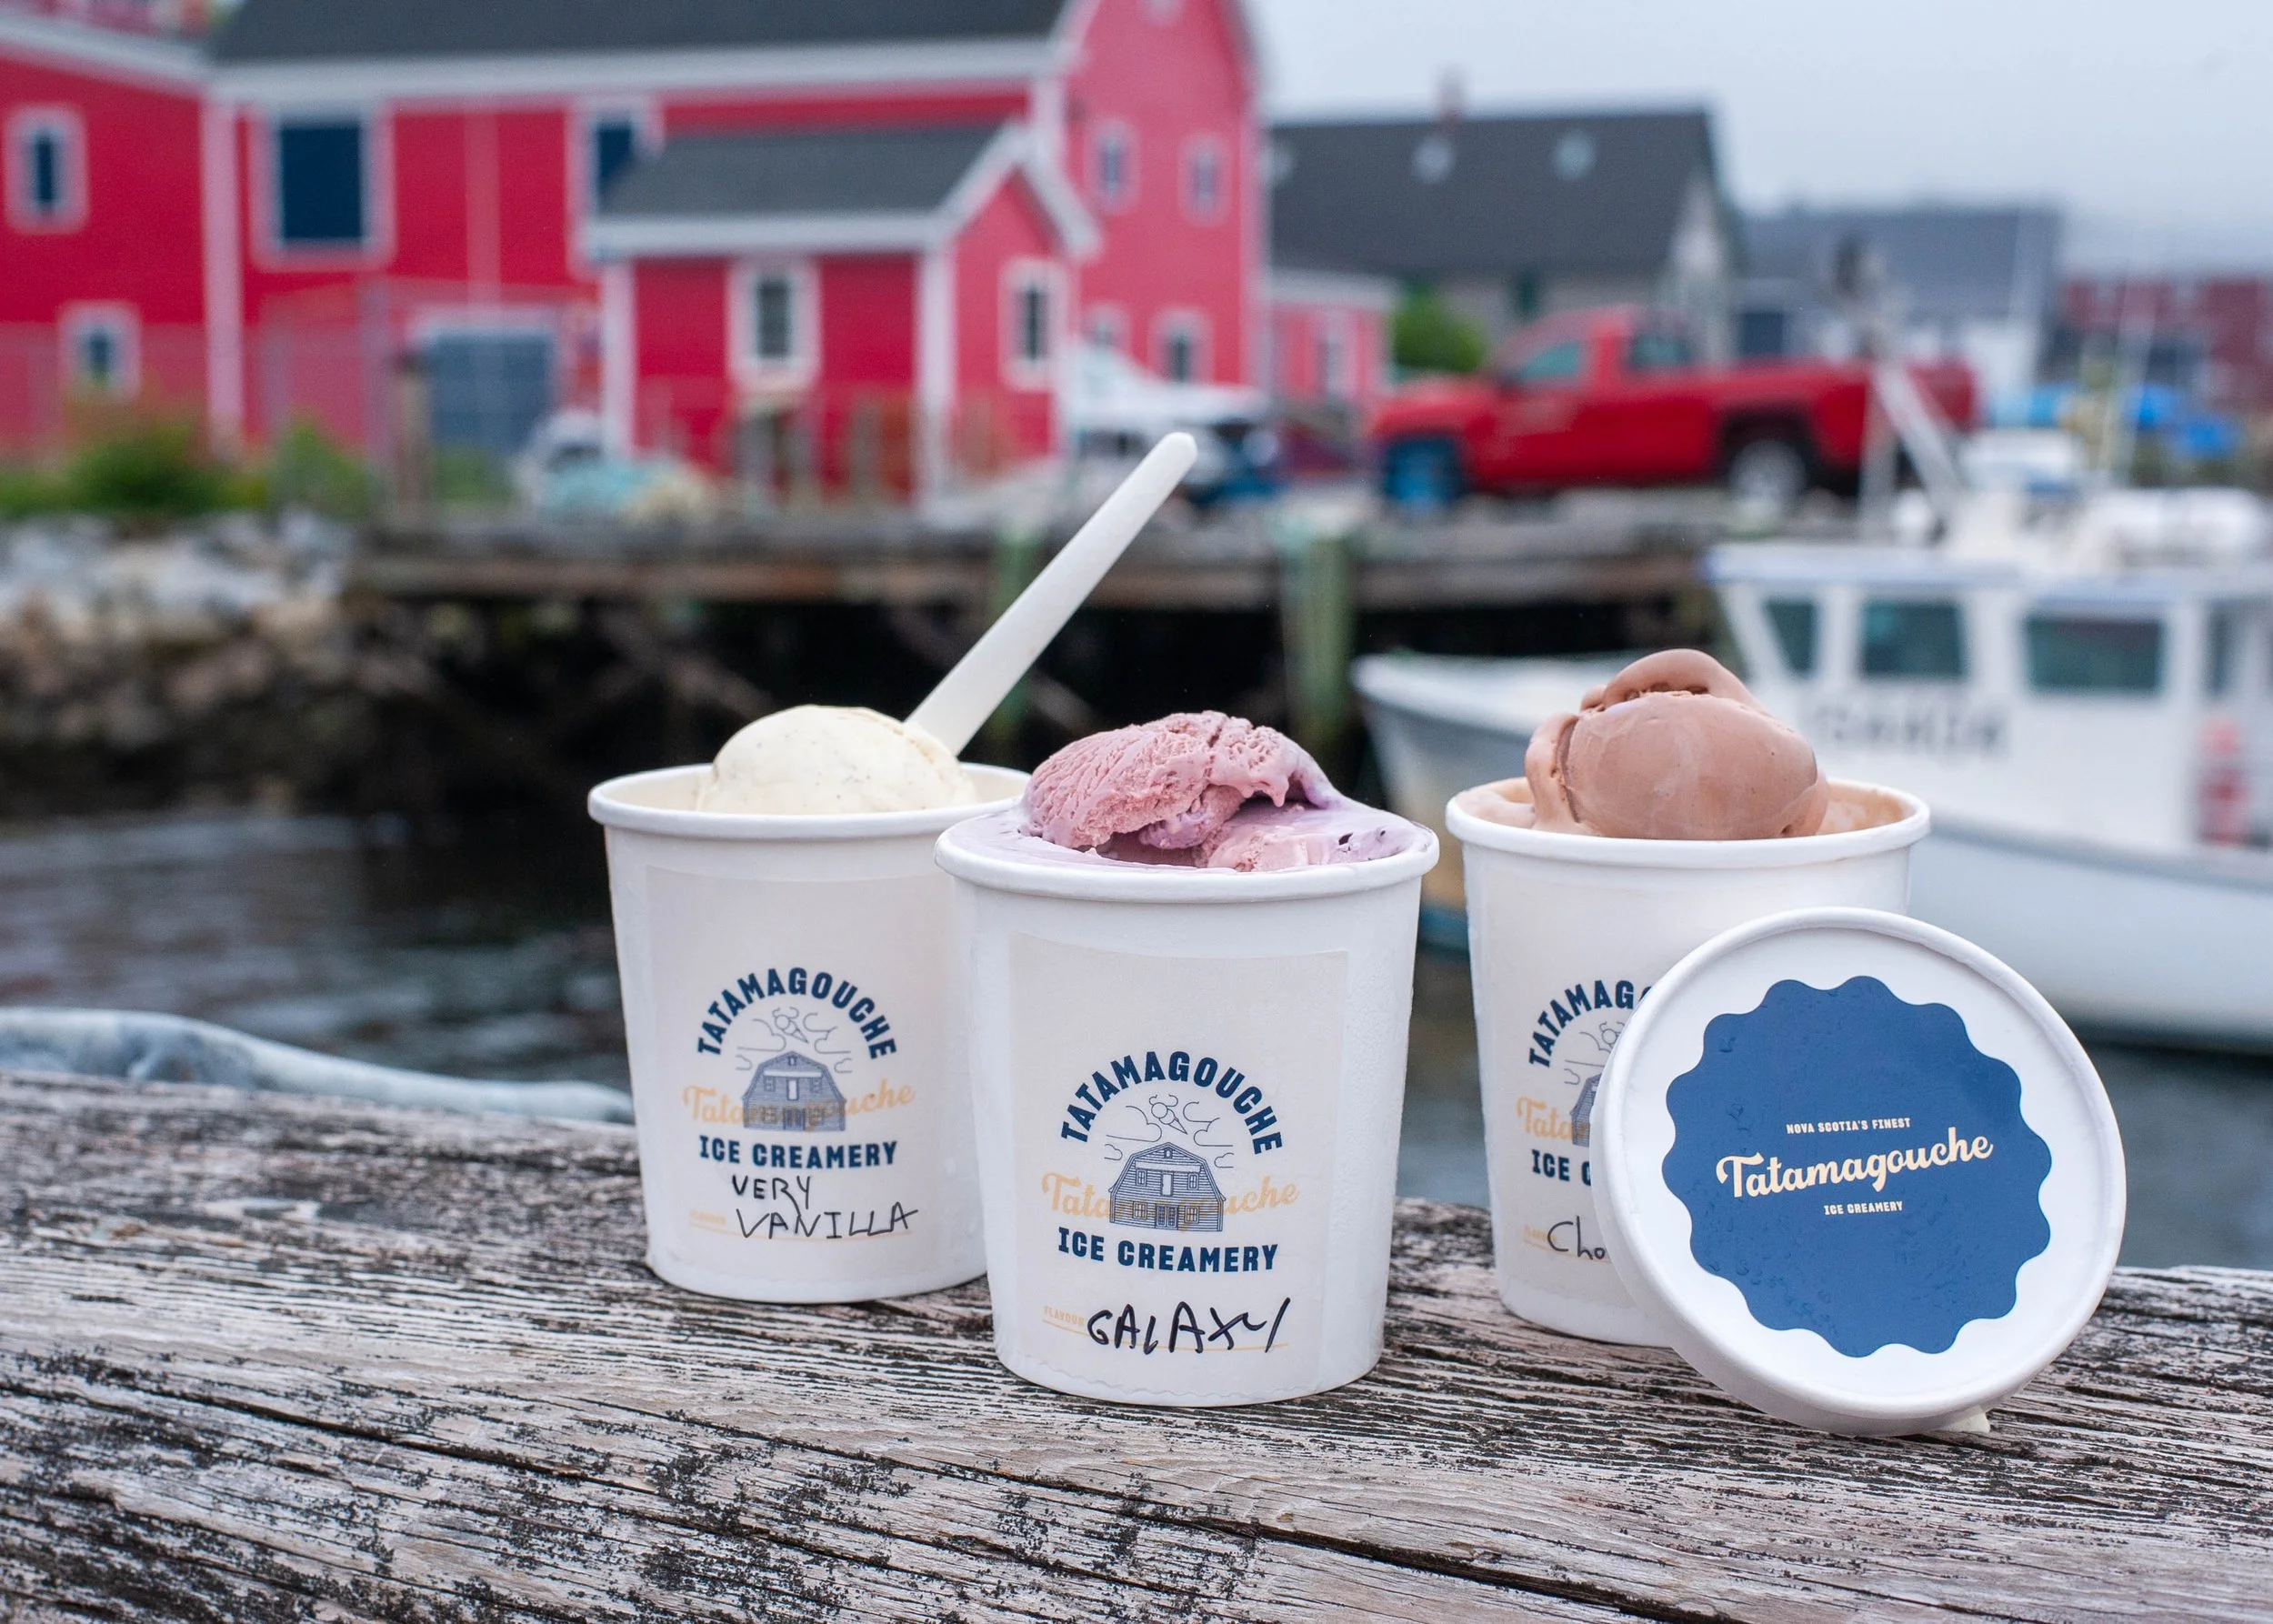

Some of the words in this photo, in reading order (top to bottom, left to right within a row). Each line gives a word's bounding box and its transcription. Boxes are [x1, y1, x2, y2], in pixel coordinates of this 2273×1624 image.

[697, 967, 897, 1059] TATAMAGOUCHE
[1061, 1051, 1283, 1155] TATAMAGOUCHE
[1786, 1123, 1815, 1135] NOVA
[1817, 1119, 1868, 1133] SCOTIA'S
[1872, 1118, 1911, 1129] FINEST
[699, 1135, 741, 1164] ICE
[752, 1141, 898, 1169] CREAMERY
[1531, 1148, 1571, 1182] ICE
[1716, 1127, 1995, 1198] Tatamagouche
[731, 1175, 811, 1216] VERY
[1823, 1205, 1845, 1216] ICE
[1847, 1200, 1903, 1215] CREAMERY
[736, 1200, 920, 1239] VANILLA
[1057, 1227, 1105, 1261] ICE
[1117, 1240, 1279, 1272] CREAMERY
[1086, 1297, 1291, 1355] GALAXY
